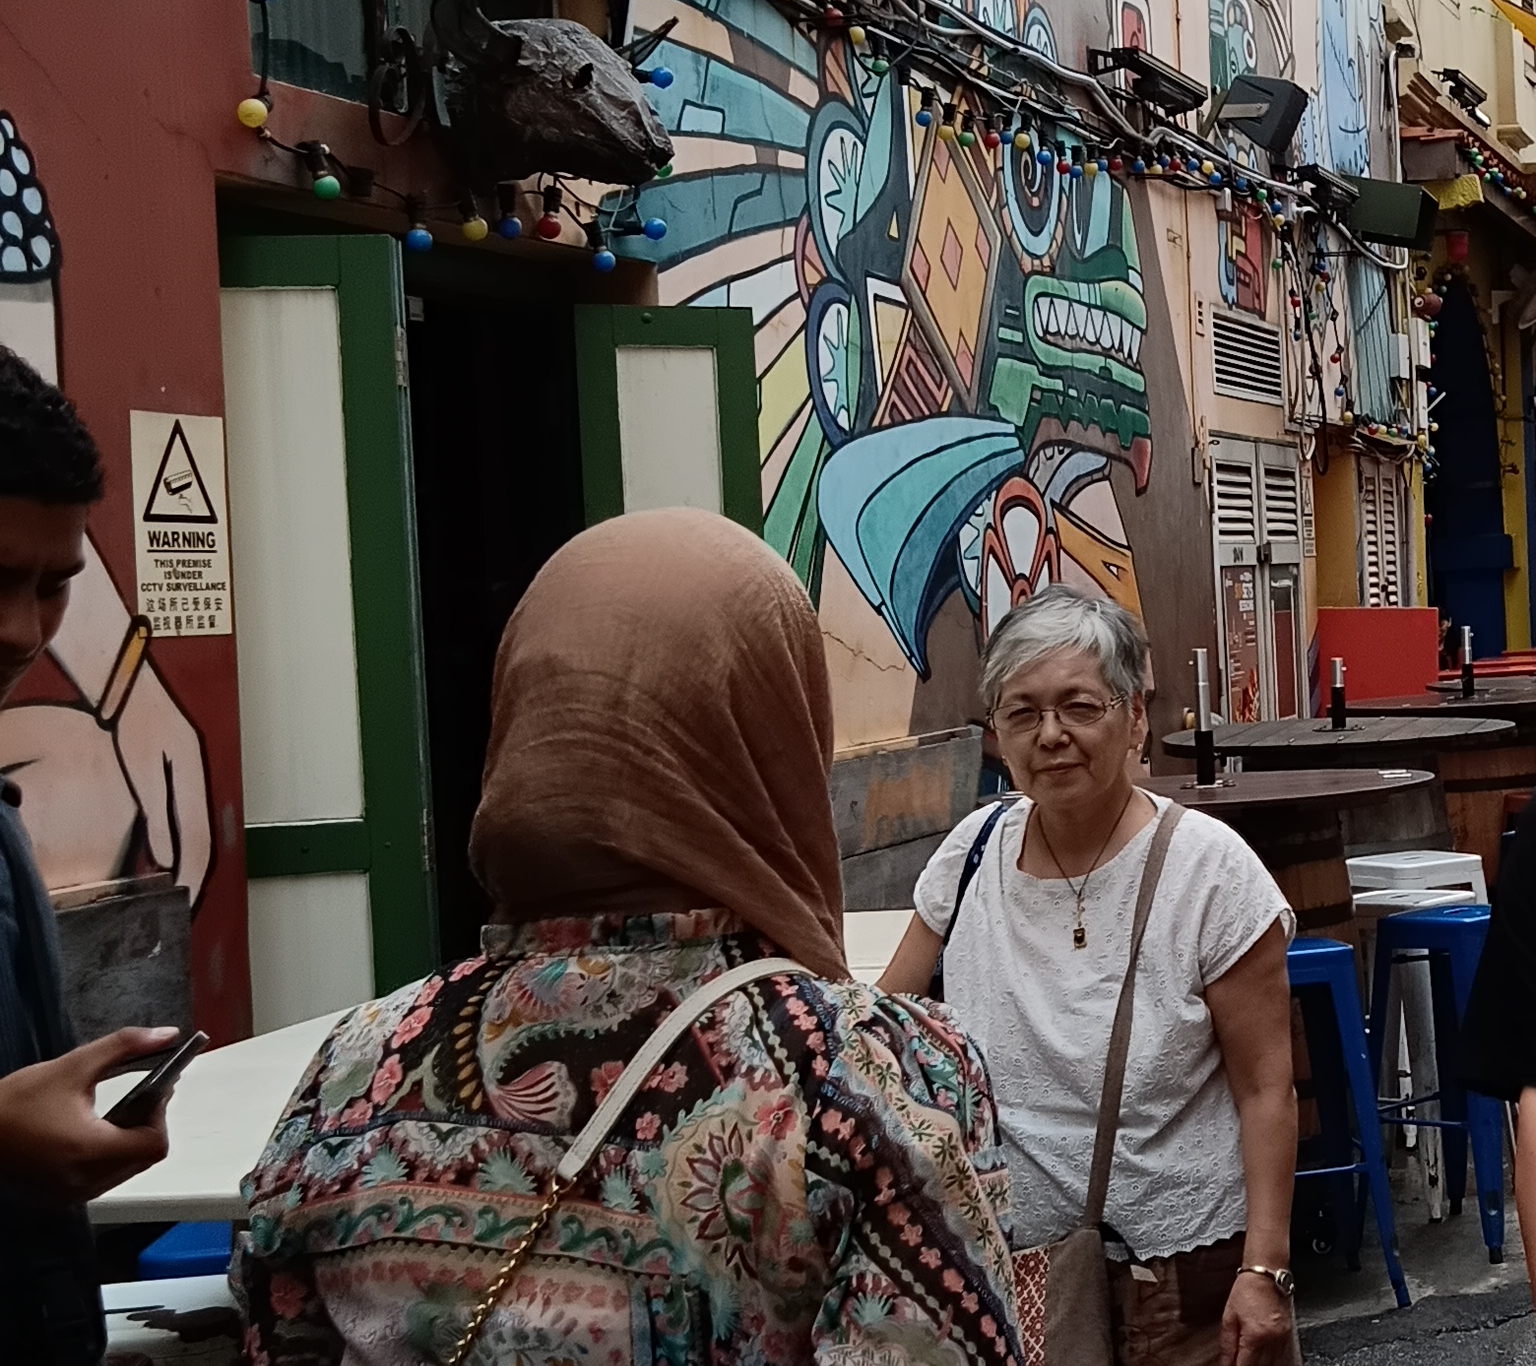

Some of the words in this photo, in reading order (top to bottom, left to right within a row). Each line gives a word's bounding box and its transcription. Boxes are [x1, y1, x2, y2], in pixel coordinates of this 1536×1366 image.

[147, 530, 216, 549] WARNING
[153, 558, 174, 569] THIS
[175, 559, 212, 569] PREMISE
[163, 570, 172, 580] IS
[174, 570, 203, 580] UNDER
[140, 581, 164, 592] CCTV
[166, 581, 227, 592] SURVEILLANCE
